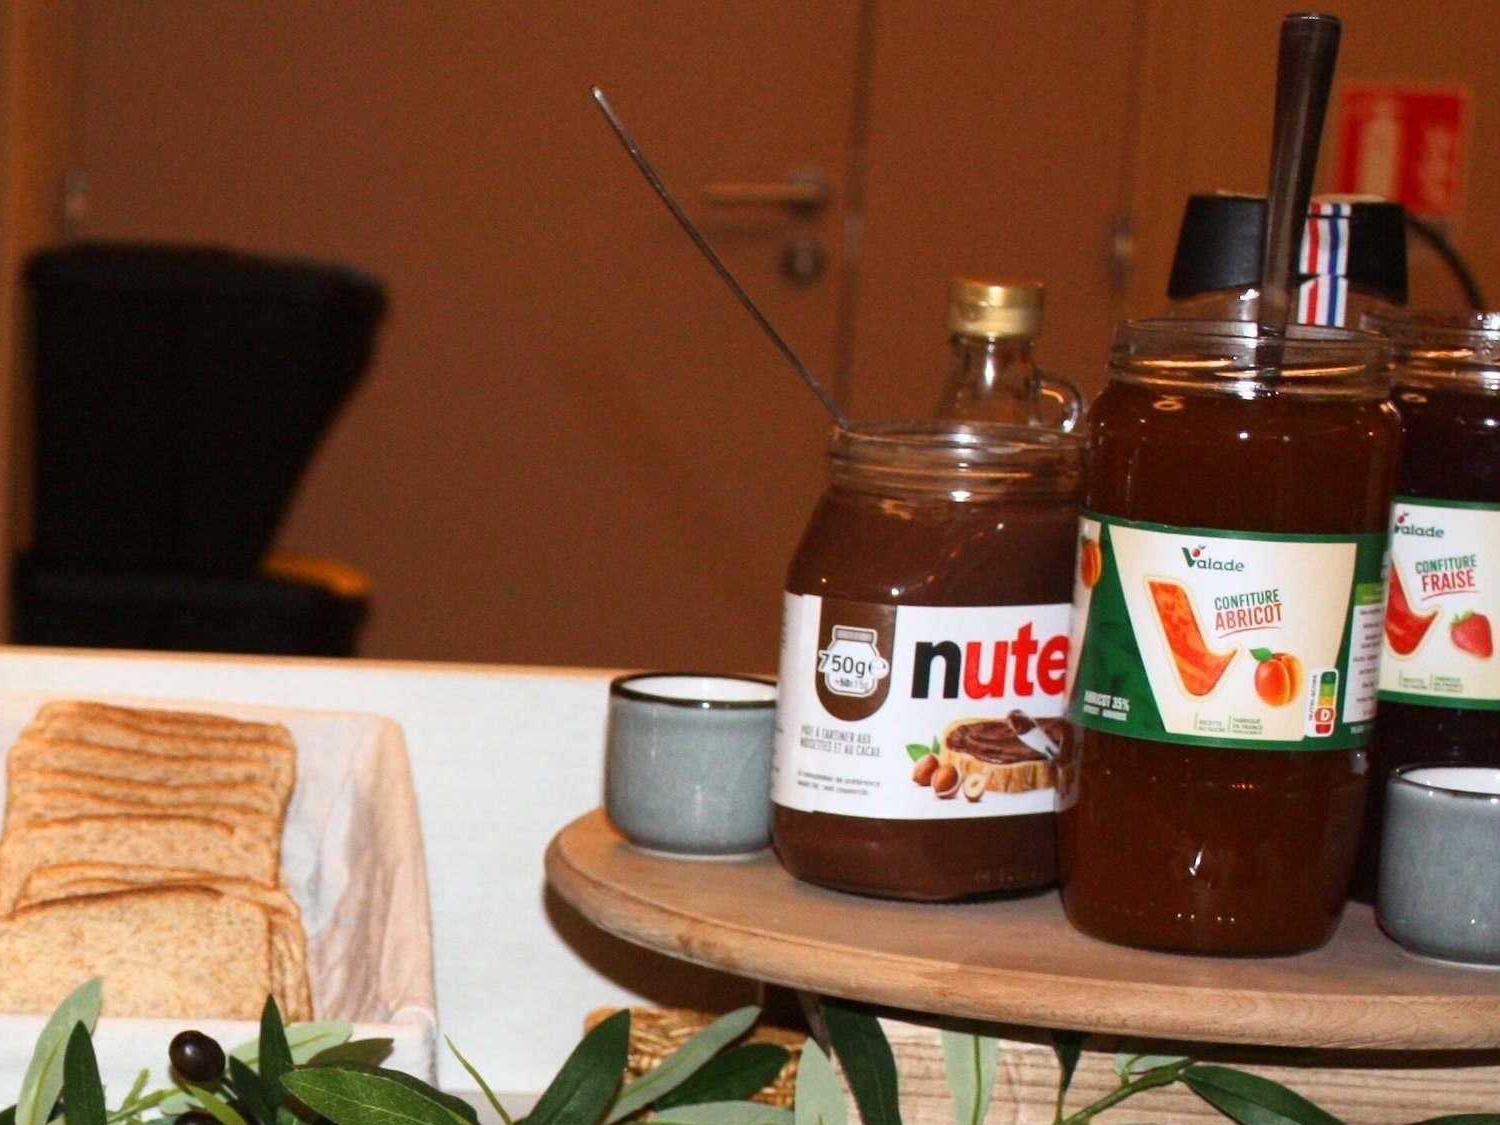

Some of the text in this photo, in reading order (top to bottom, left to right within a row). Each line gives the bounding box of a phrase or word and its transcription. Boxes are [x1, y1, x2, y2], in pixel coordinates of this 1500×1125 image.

[1181, 545, 1246, 572] Valade
[1415, 554, 1477, 574] CONFITURE
[1421, 569, 1476, 592] FRAISE
[1214, 588, 1280, 611] CONFITURE
[1215, 602, 1283, 630] ABRICOT
[819, 652, 866, 679] 750g
[1320, 708, 1329, 721] D
